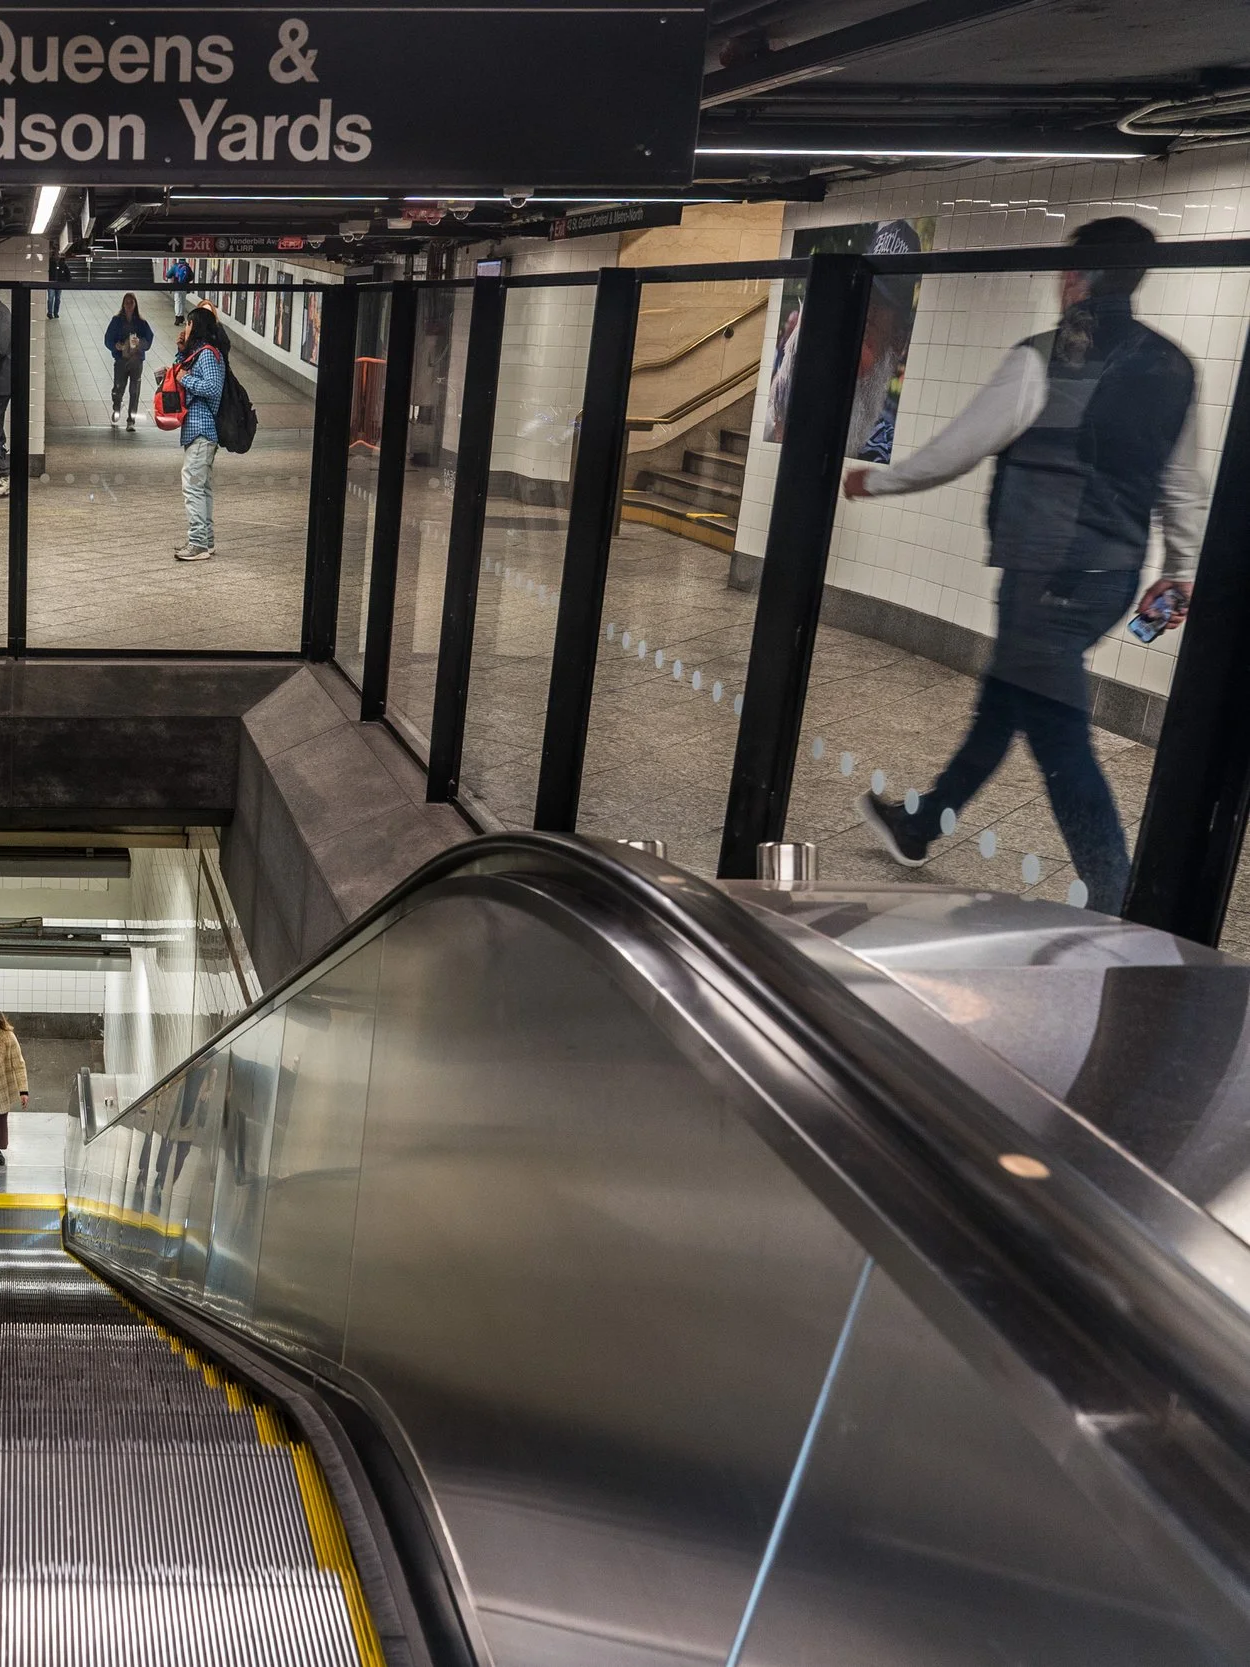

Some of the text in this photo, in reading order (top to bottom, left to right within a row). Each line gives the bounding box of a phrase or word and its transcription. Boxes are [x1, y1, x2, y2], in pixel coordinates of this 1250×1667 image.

[268, 18, 319, 84] &
[178, 98, 372, 163] Yards
[182, 237, 211, 250] Exit
[554, 219, 566, 237] Exit
[578, 216, 592, 229] Grand
[592, 211, 609, 227] Central
[613, 207, 644, 224] Metro-North
